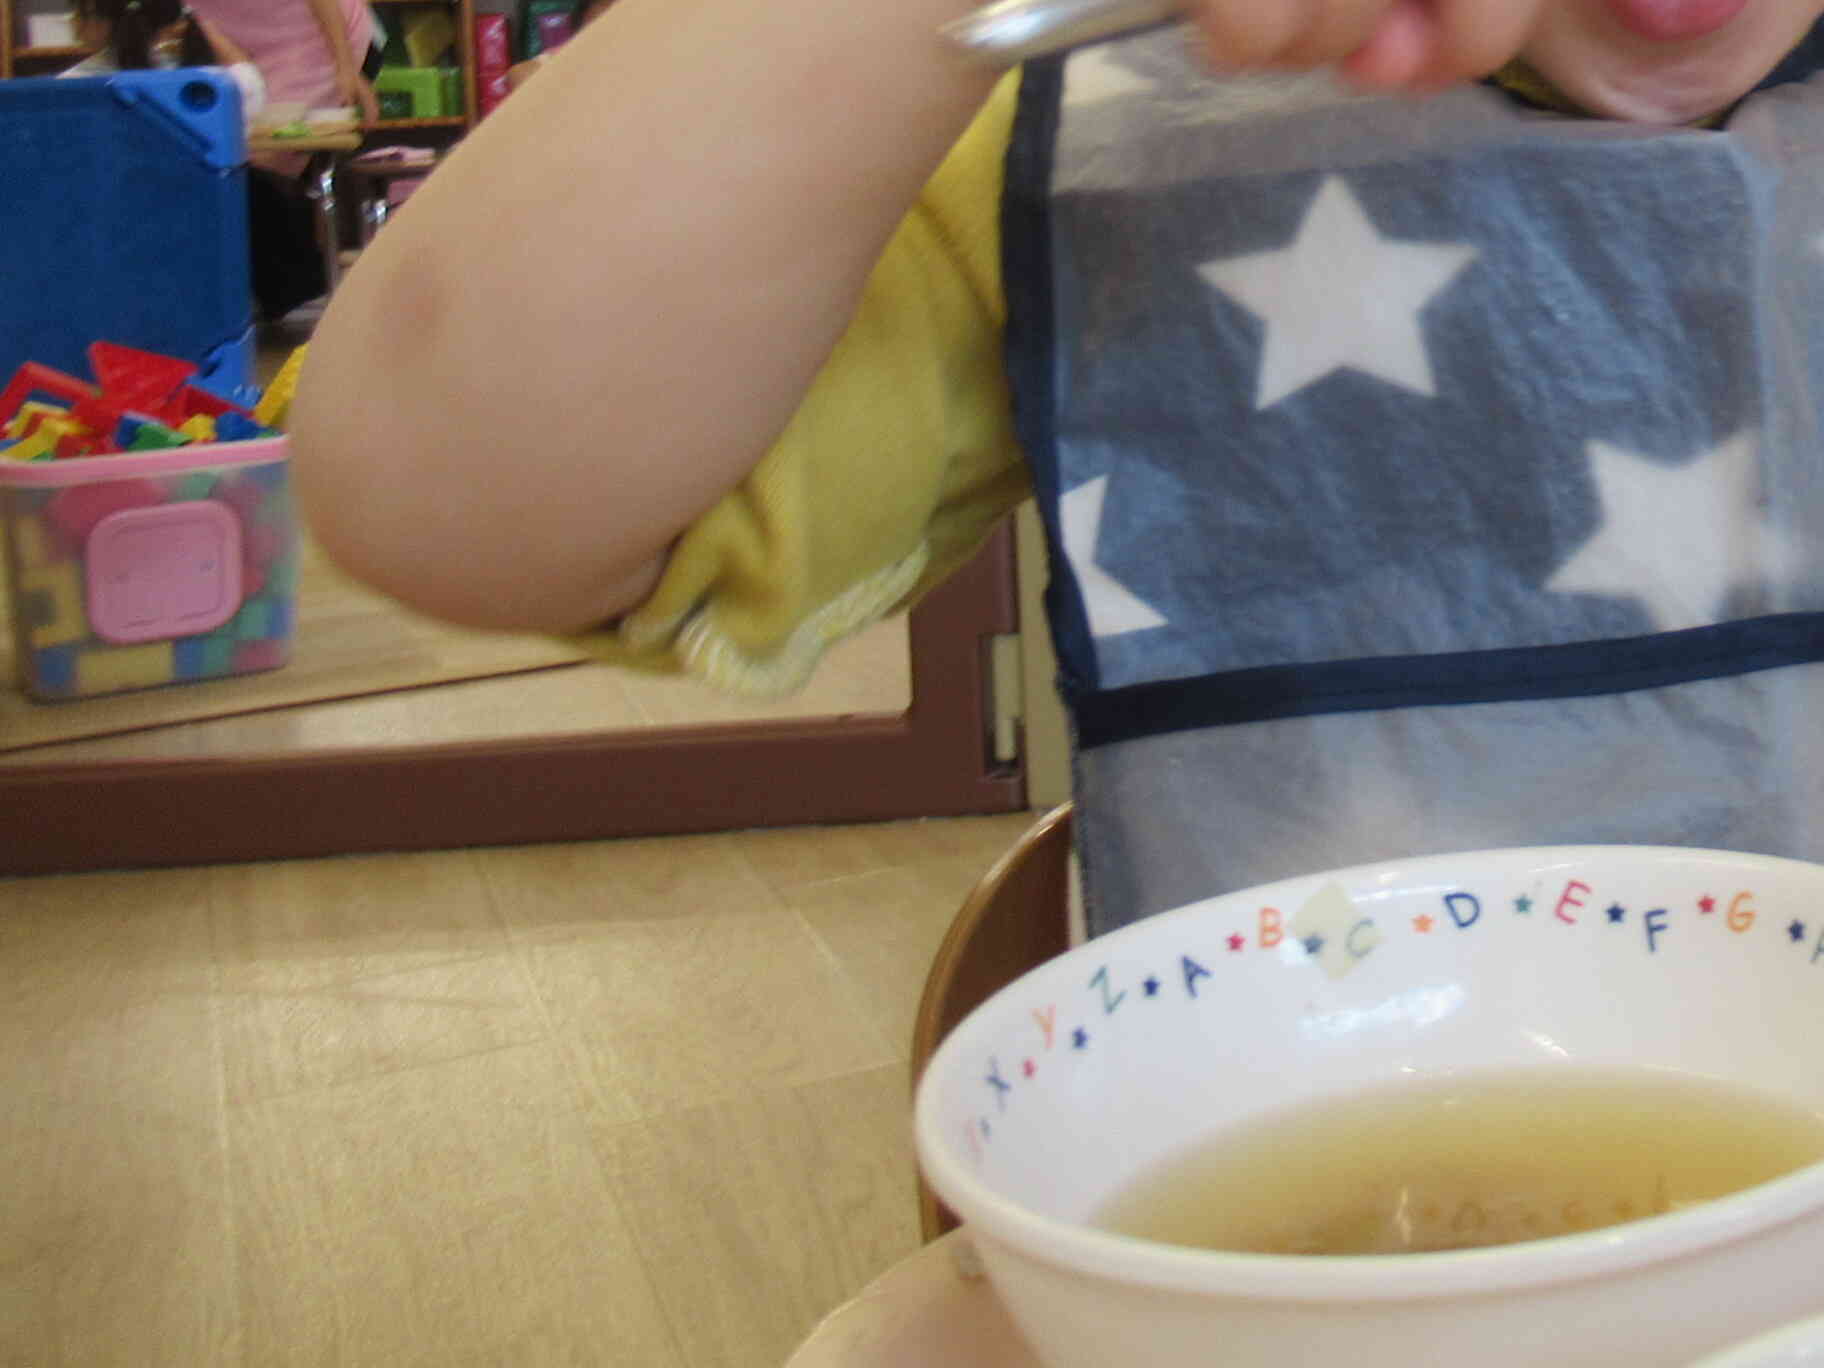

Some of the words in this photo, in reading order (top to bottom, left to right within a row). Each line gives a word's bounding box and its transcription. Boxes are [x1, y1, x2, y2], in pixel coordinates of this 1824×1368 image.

[1030, 1002, 1057, 1050] Y
[1087, 964, 1128, 1015] Z
[1180, 954, 1212, 998] A
[1257, 906, 1285, 949] B
[1344, 917, 1378, 959] C
[1443, 890, 1482, 930] D
[1553, 879, 1592, 924] E
[1643, 908, 1670, 952] F
[1725, 890, 1757, 933] G
